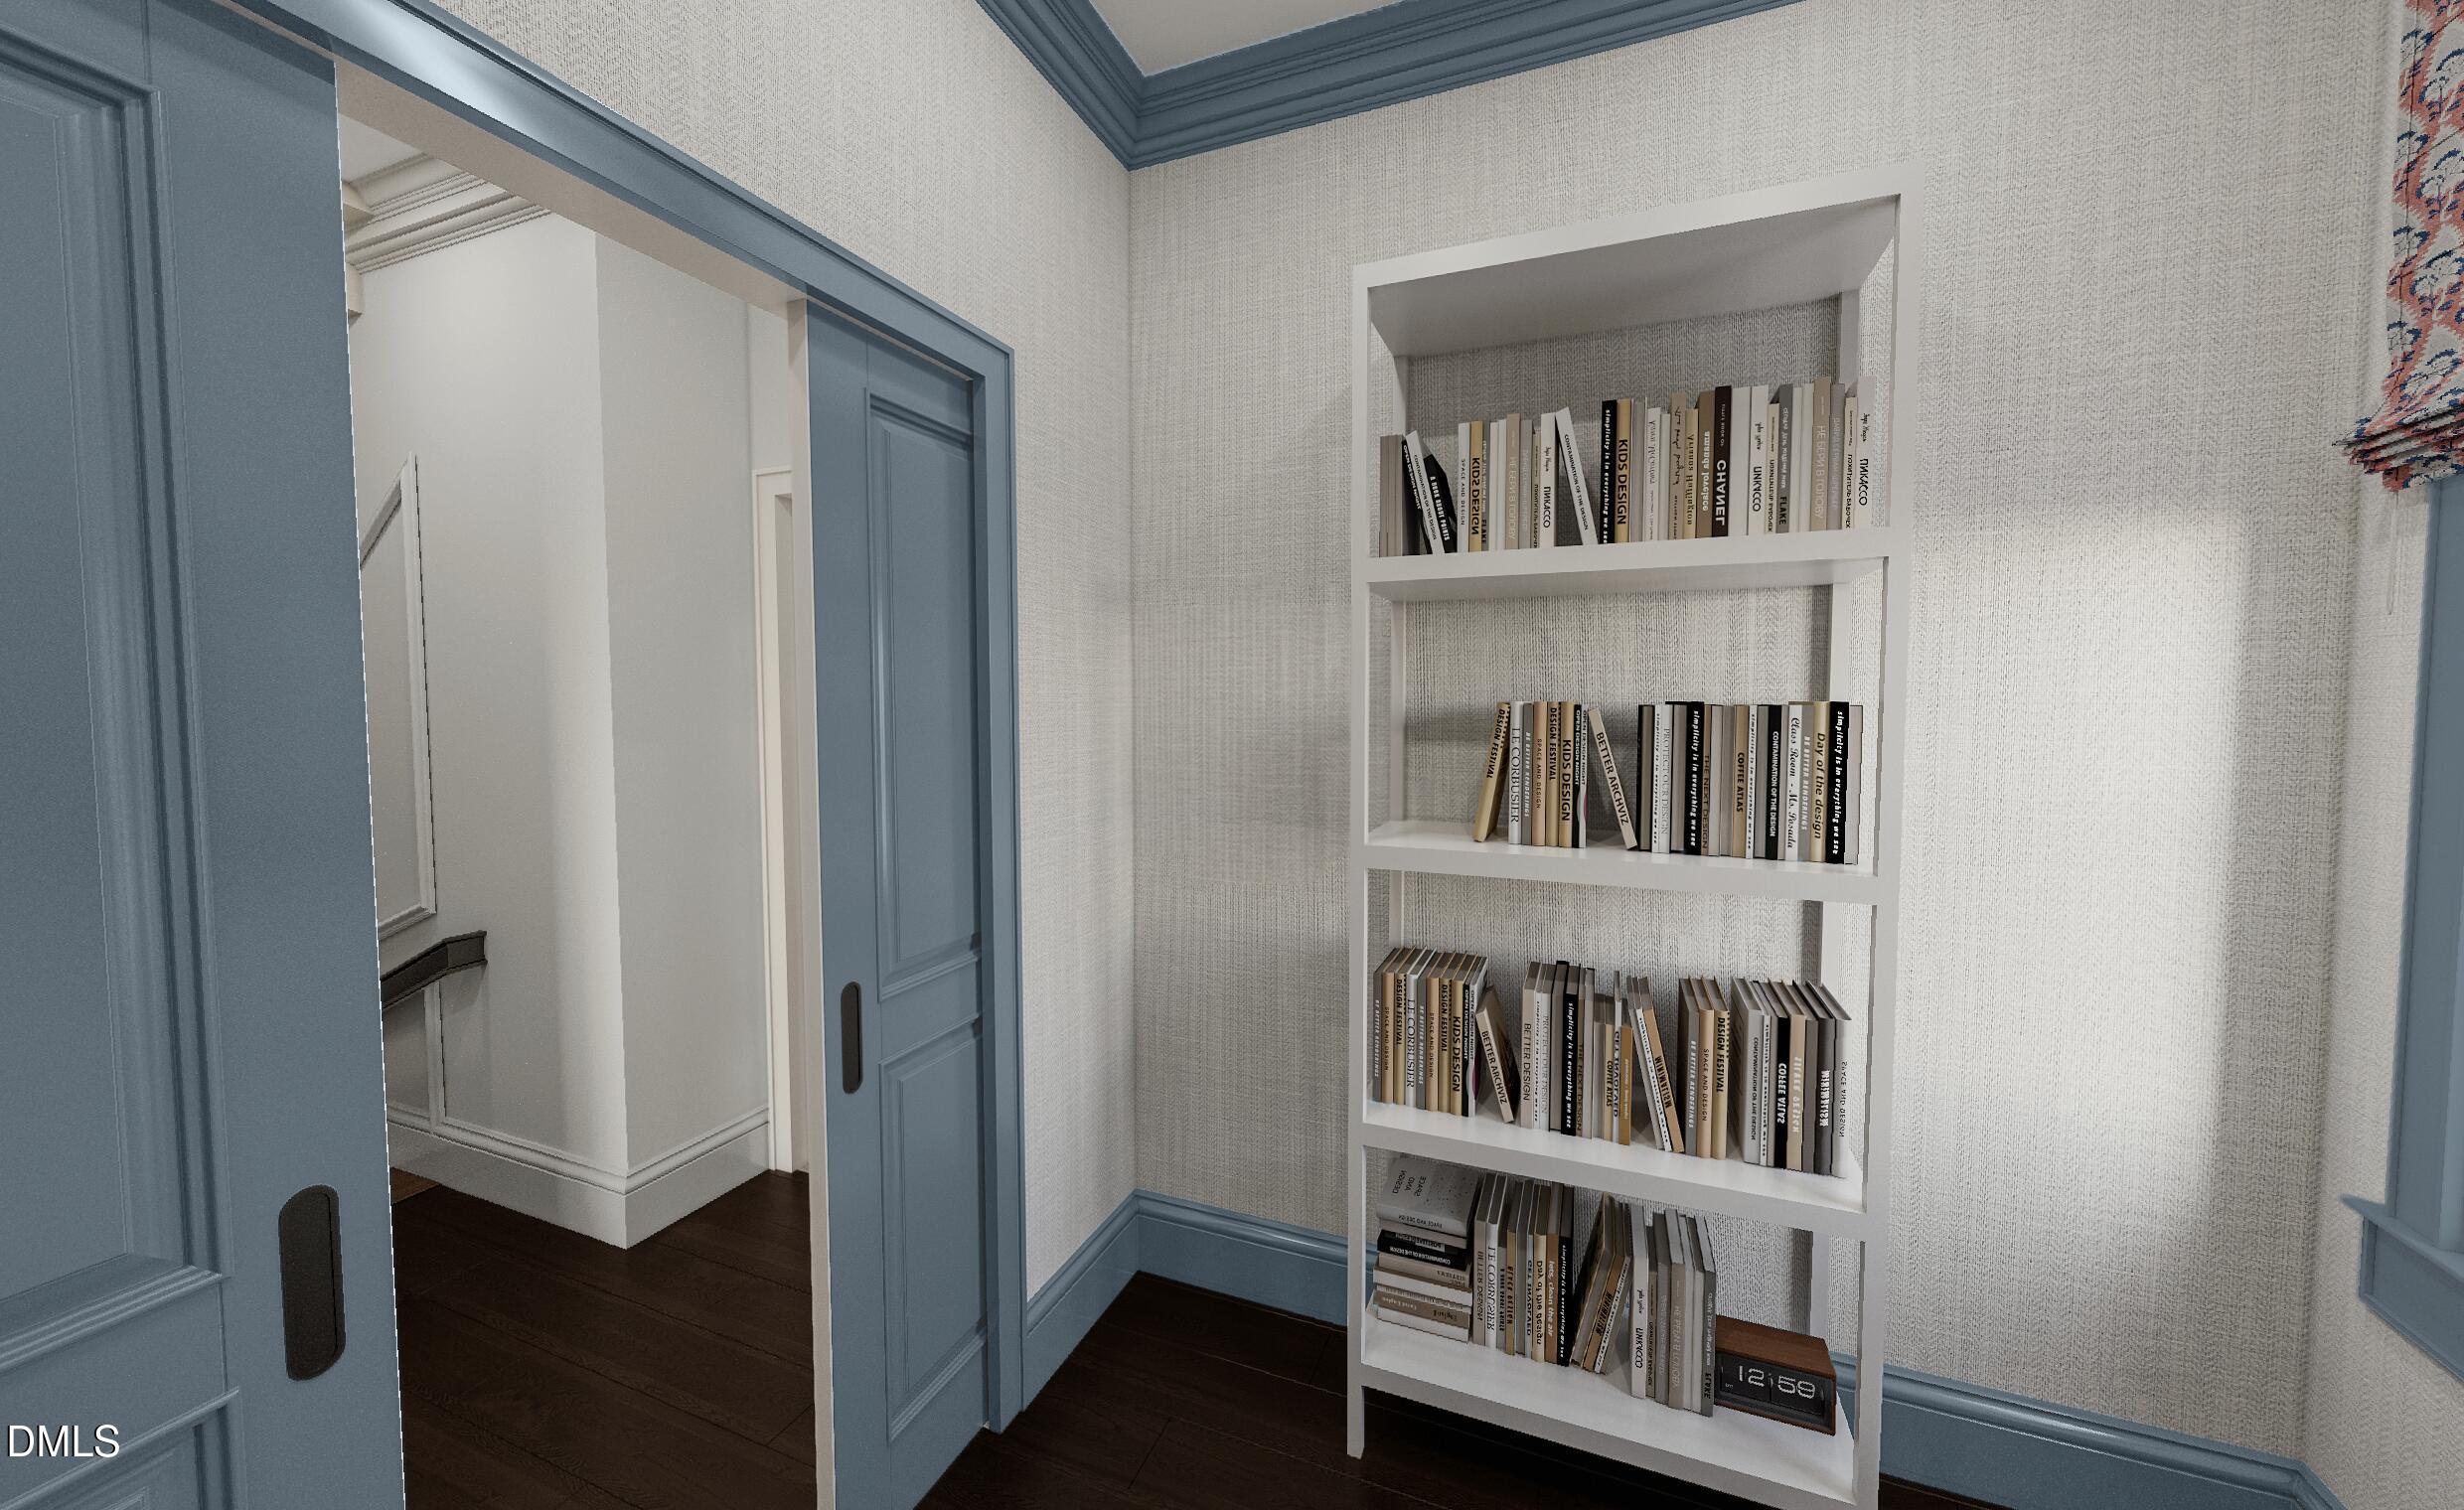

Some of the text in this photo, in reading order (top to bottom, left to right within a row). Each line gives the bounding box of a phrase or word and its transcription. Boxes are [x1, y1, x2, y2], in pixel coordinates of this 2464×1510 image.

[1816, 425, 1824, 439] НЕ
[1815, 440, 1824, 467] БЕРИ
[1564, 434, 1580, 485] CONTAMINATION
[1575, 485, 1582, 494] OF
[1580, 508, 1589, 530] DESIGN
[1617, 439, 1627, 525] KIDS DESIGN
[1815, 479, 1824, 519] ГОЛОВУ
[1858, 458, 1869, 506] ПИКАССО
[1603, 518, 1610, 528] we
[1486, 708, 1505, 778] DESIGN FESTIVAL
[1790, 717, 1800, 744] Class
[1803, 736, 1810, 746] BE
[1834, 711, 1845, 754] simplicity
[1510, 727, 1521, 823] LE CORBUSIER
[1691, 763, 1698, 772] in
[1771, 731, 1779, 787] CONTAMINATION
[1789, 748, 1799, 776] Room
[1834, 756, 1843, 765] is
[1562, 739, 1572, 821] KIDS DESIGN
[1597, 732, 1628, 826] BETTER ARCHVIZ
[1771, 788, 1777, 797] OF
[1812, 732, 1826, 838] Day of the design
[1736, 786, 1745, 812] ATLAS
[1833, 778, 1842, 824] everything
[1690, 820, 1697, 830] we
[1787, 812, 1797, 848] Posada
[1832, 826, 1841, 837] we
[1407, 998, 1415, 1014] LE
[1690, 1040, 1696, 1049] BE
[1716, 1017, 1726, 1093] DESIGN FESTIVAL
[1481, 1030, 1507, 1105] BETTER ARCHVIZ
[1566, 1103, 1572, 1113] we
[1596, 1290, 1614, 1337] MINIMALISM
[1739, 1365, 1815, 1399] 12 59
